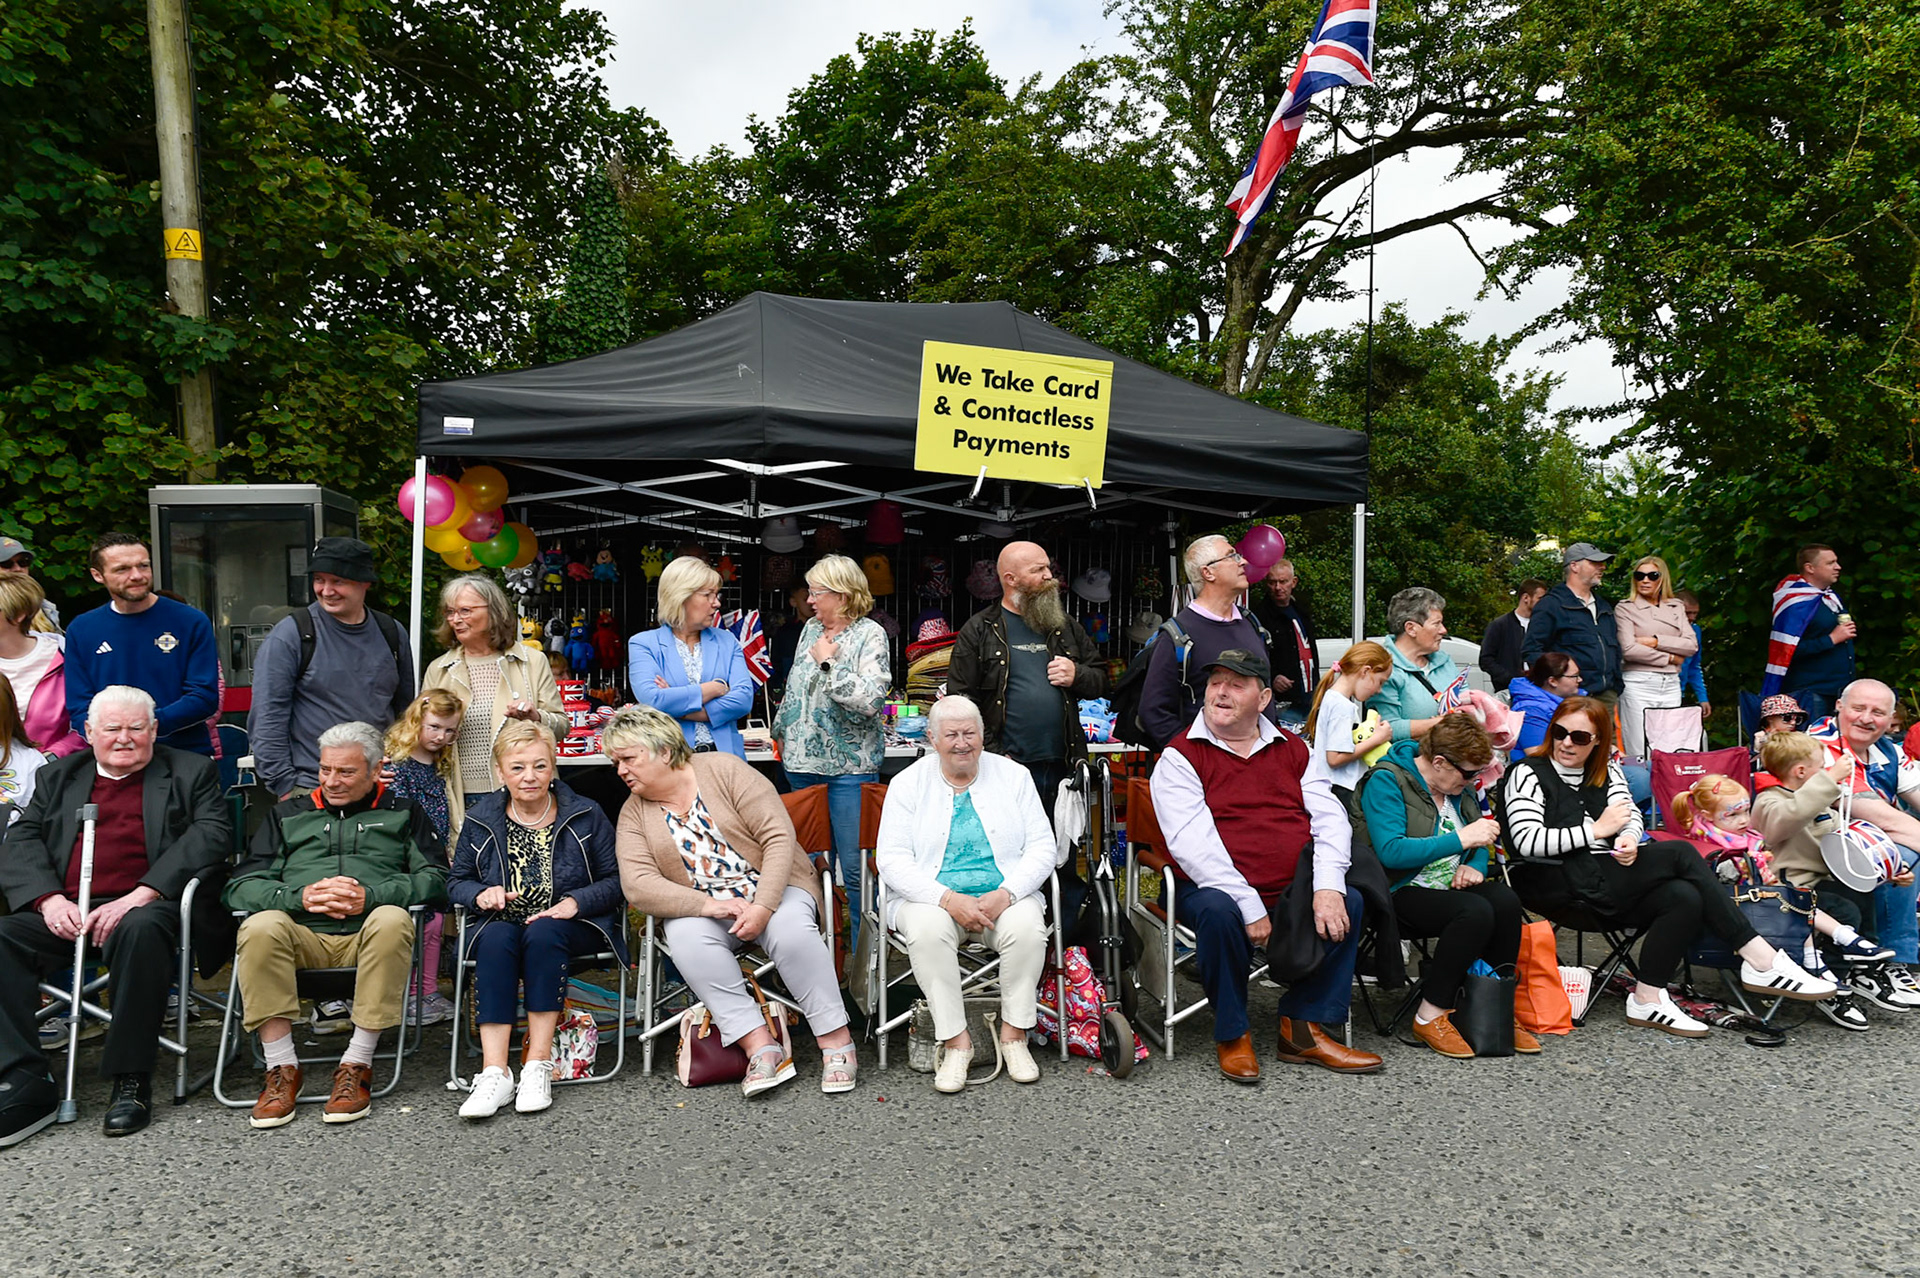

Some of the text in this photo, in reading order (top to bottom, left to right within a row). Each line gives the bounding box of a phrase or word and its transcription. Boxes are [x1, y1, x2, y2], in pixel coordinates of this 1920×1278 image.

[935, 363, 1100, 400] We Take Card
[933, 396, 1094, 431] & Contactless
[953, 428, 1070, 459] Payments
